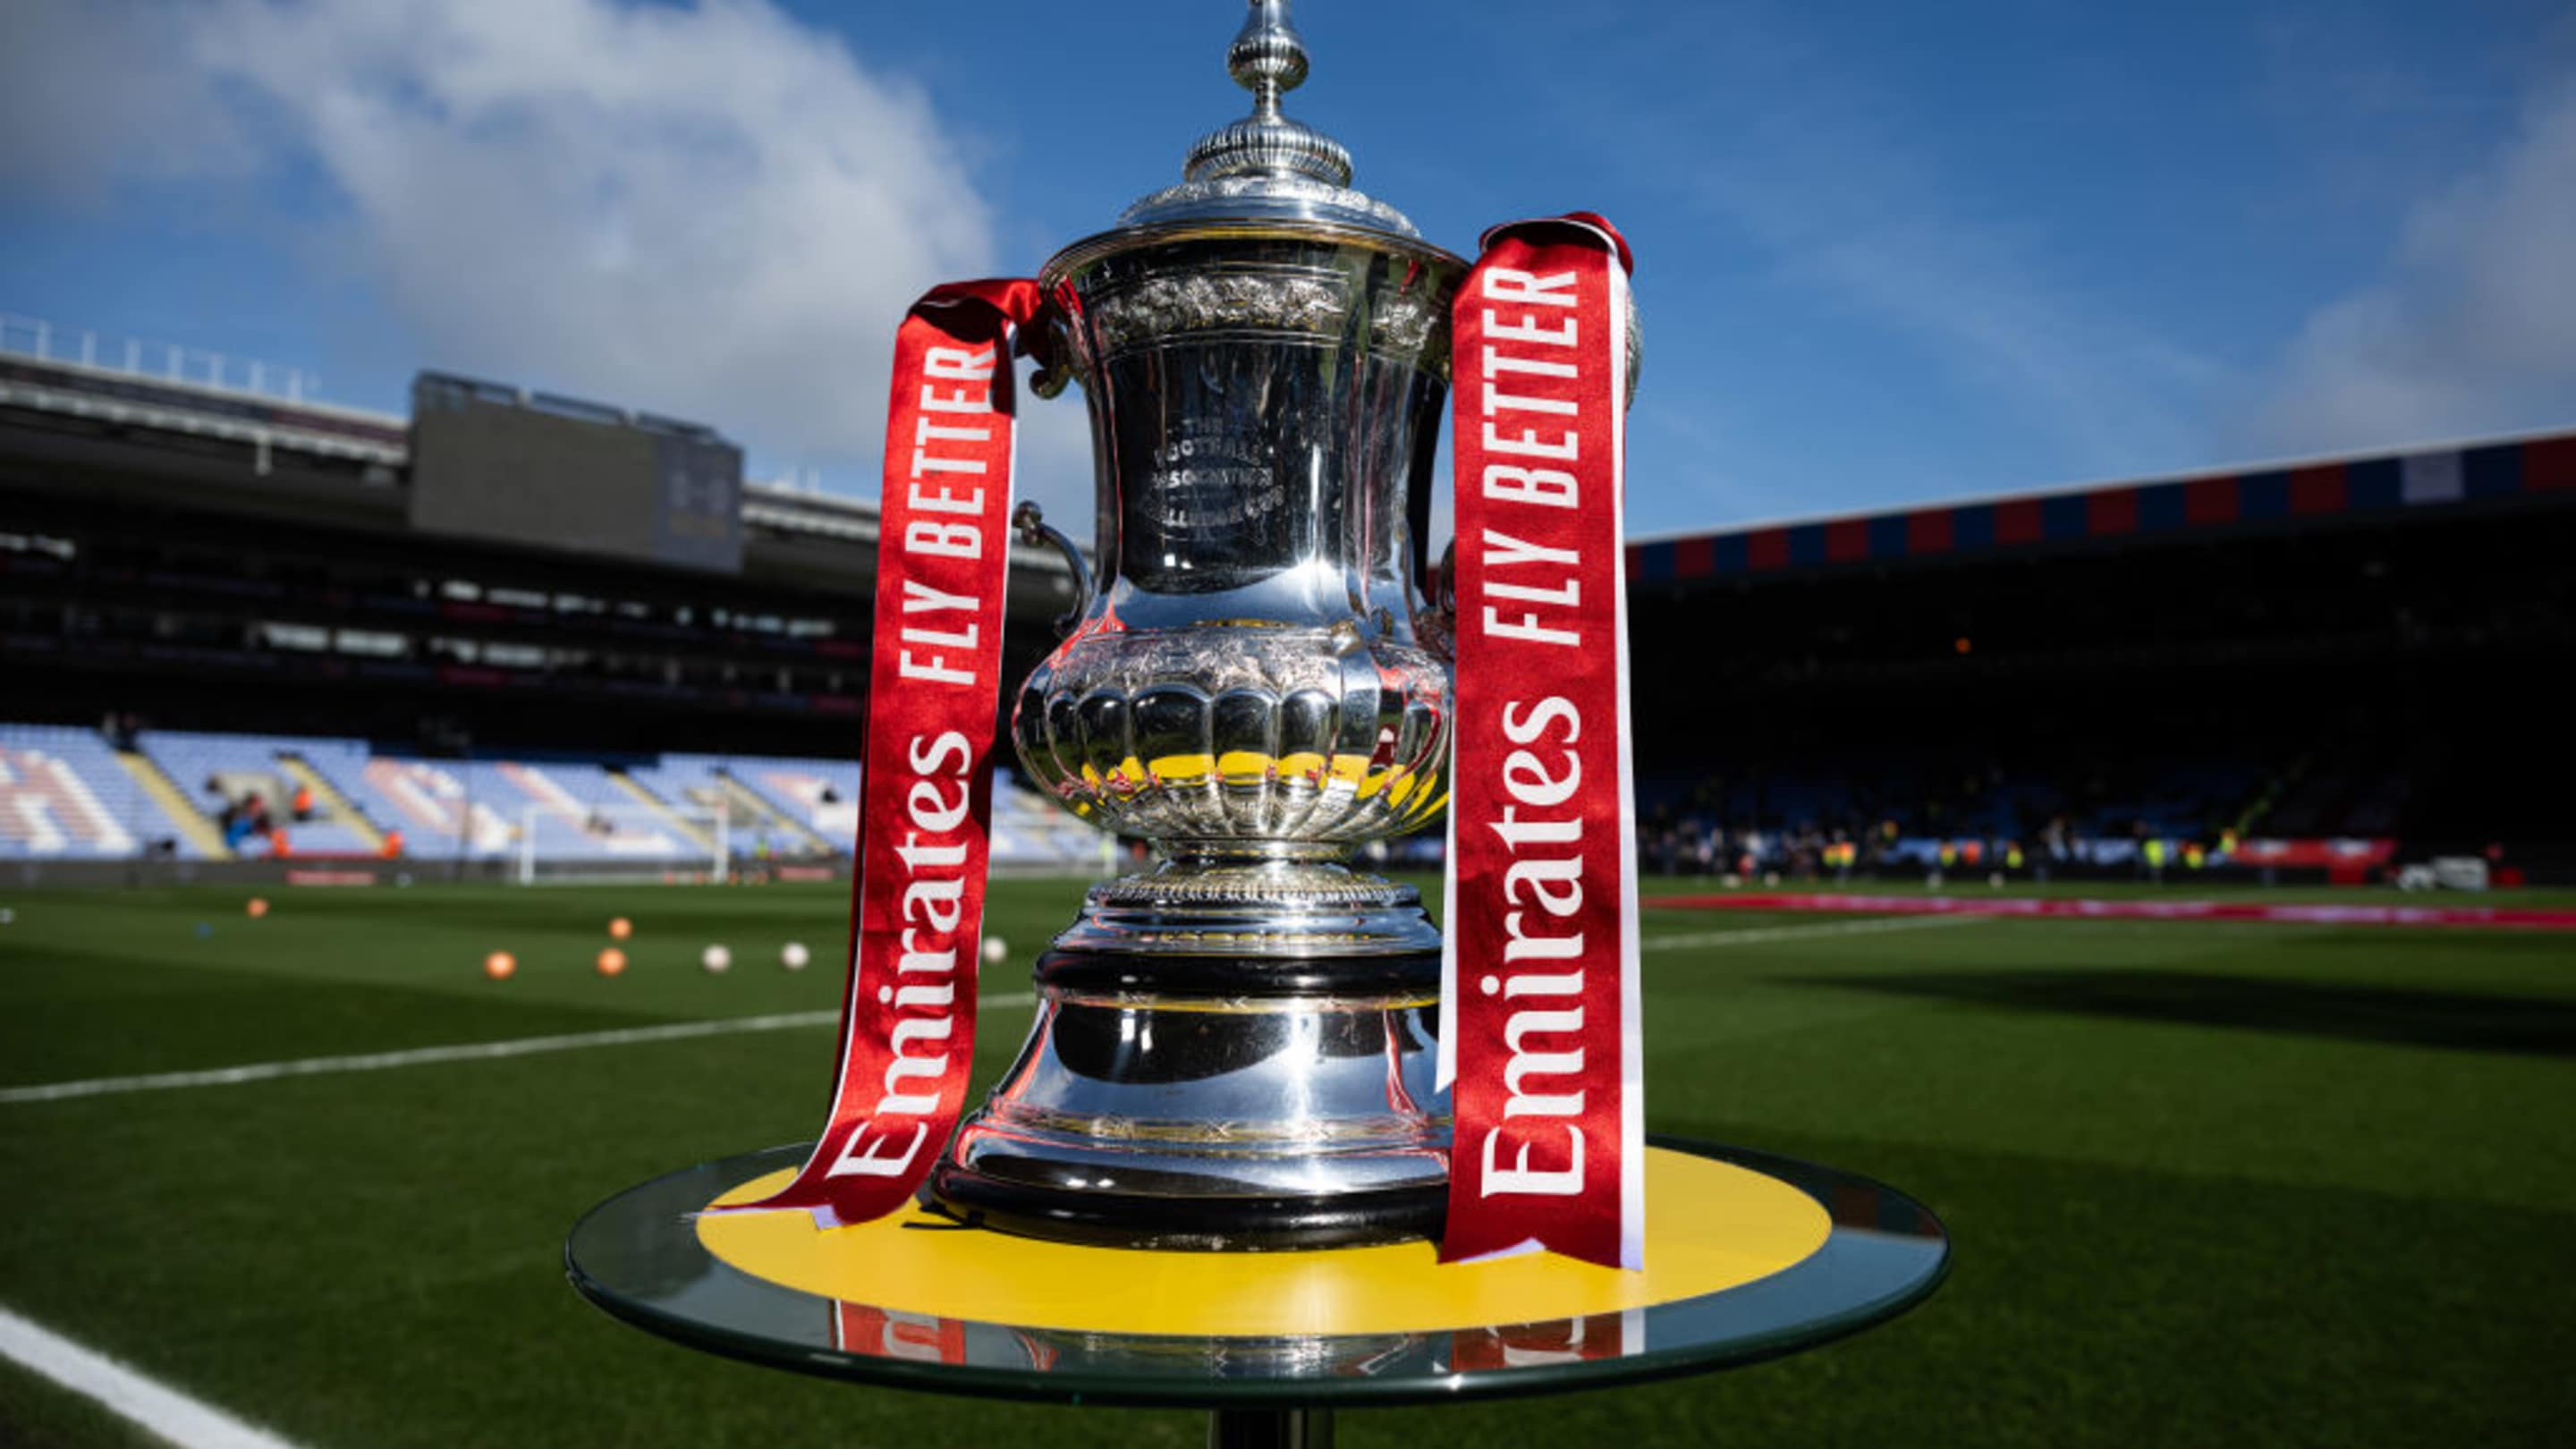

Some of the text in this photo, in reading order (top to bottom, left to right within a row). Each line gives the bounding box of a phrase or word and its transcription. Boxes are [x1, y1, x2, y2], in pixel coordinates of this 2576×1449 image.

[825, 345, 996, 1179] Emirates FLY BETTER
[1480, 266, 1585, 1198] Emirates FLY BETTER
